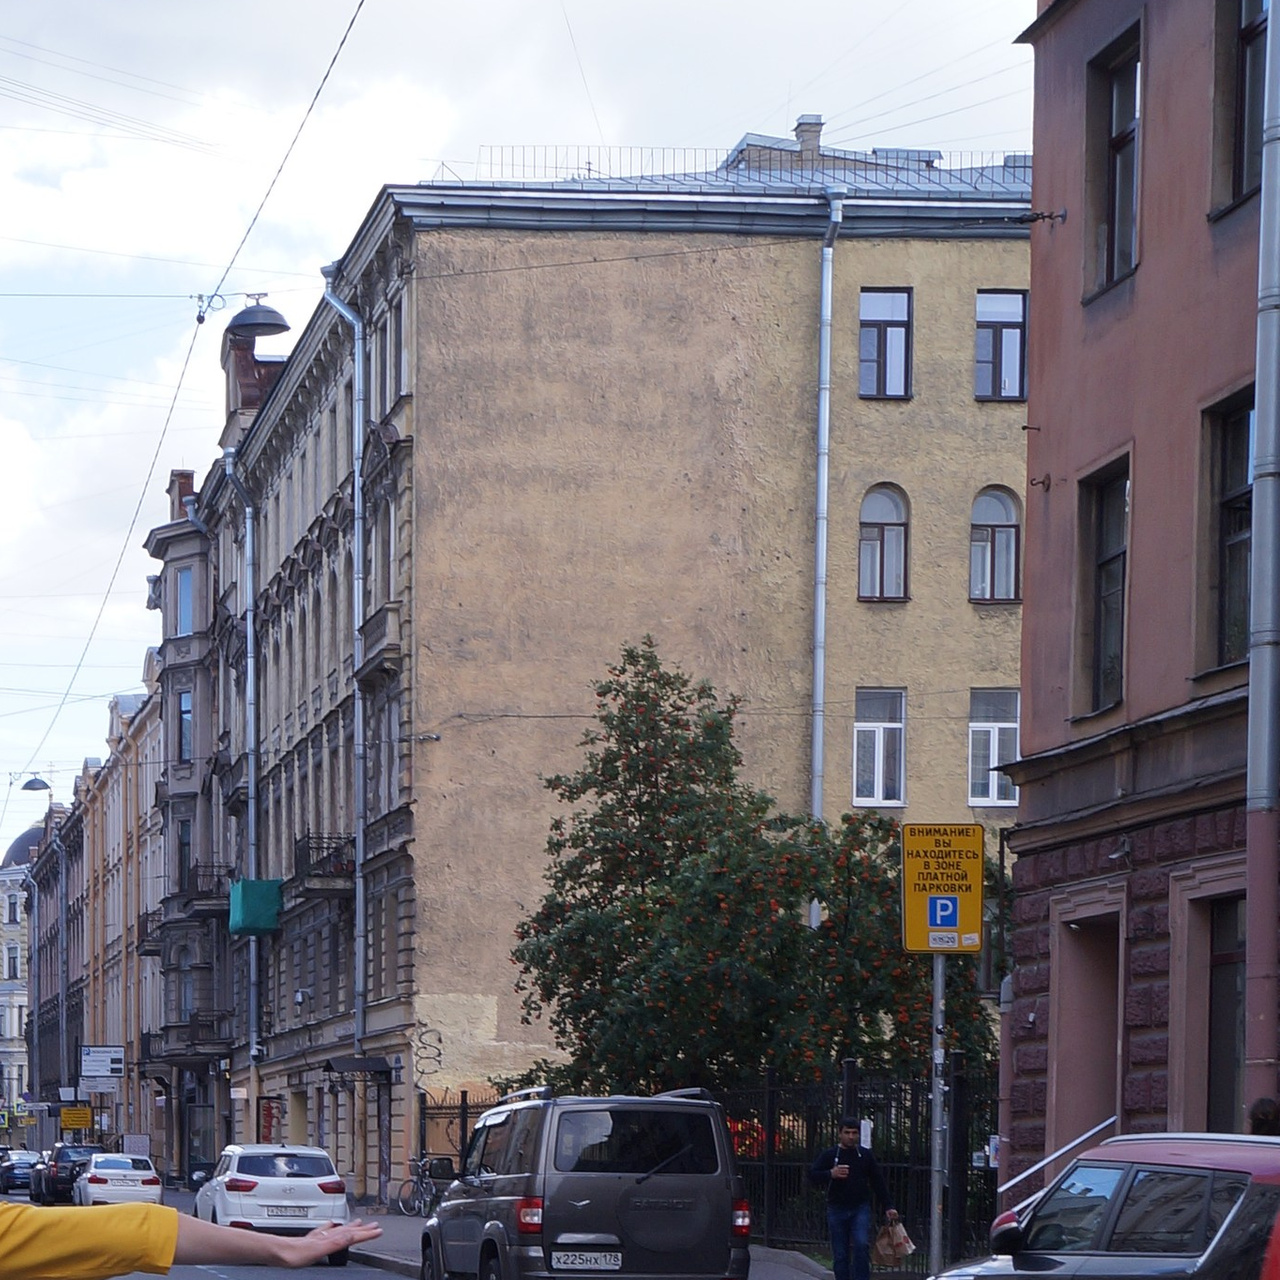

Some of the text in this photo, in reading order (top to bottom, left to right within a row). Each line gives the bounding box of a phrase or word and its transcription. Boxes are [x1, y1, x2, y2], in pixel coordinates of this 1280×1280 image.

[909, 827, 976, 837] ВНИМАНИЕ!
[934, 838, 952, 848] ВЫ
[906, 850, 979, 860] НАХОДИТЕСЬ
[923, 861, 962, 870] В ЗОНЕ
[917, 870, 968, 881] ПЛАТНОЙ
[913, 883, 972, 892] ПАРКОВКИ
